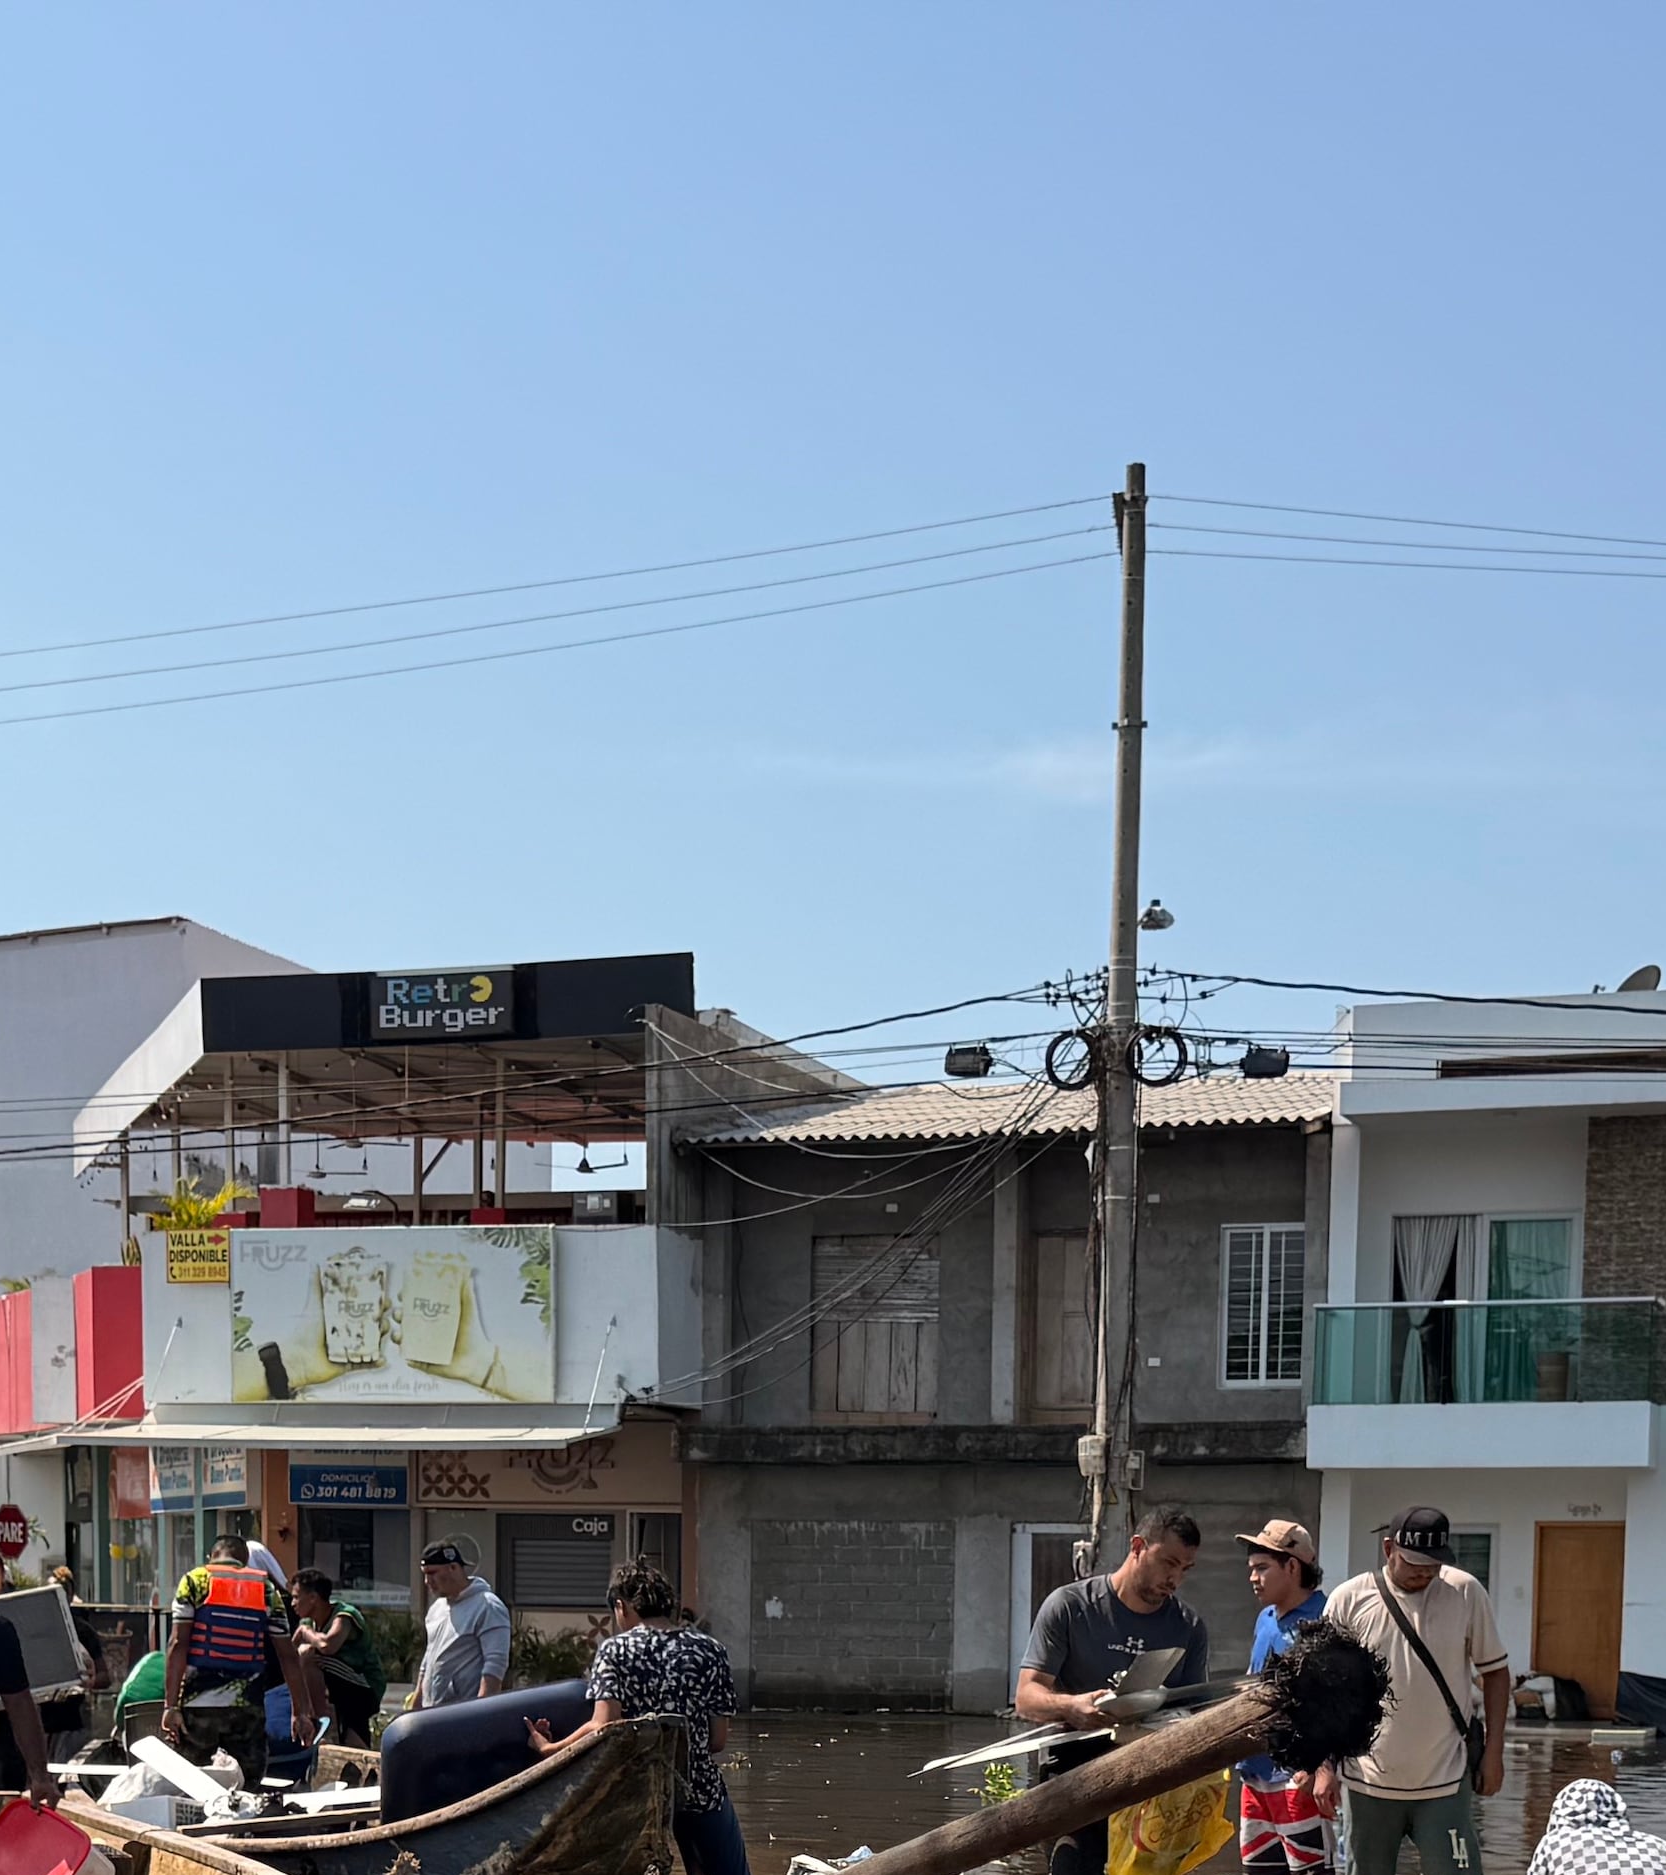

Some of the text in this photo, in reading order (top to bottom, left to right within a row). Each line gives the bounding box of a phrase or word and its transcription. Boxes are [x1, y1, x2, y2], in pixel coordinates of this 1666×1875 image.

[379, 1004, 504, 1032] Burger
[169, 1233, 206, 1247] VALLA
[169, 1249, 228, 1263] DISPONIBLE
[316, 1485, 338, 1498] 301
[572, 1517, 609, 1536] Caja
[1447, 1828, 1470, 1869] LA
